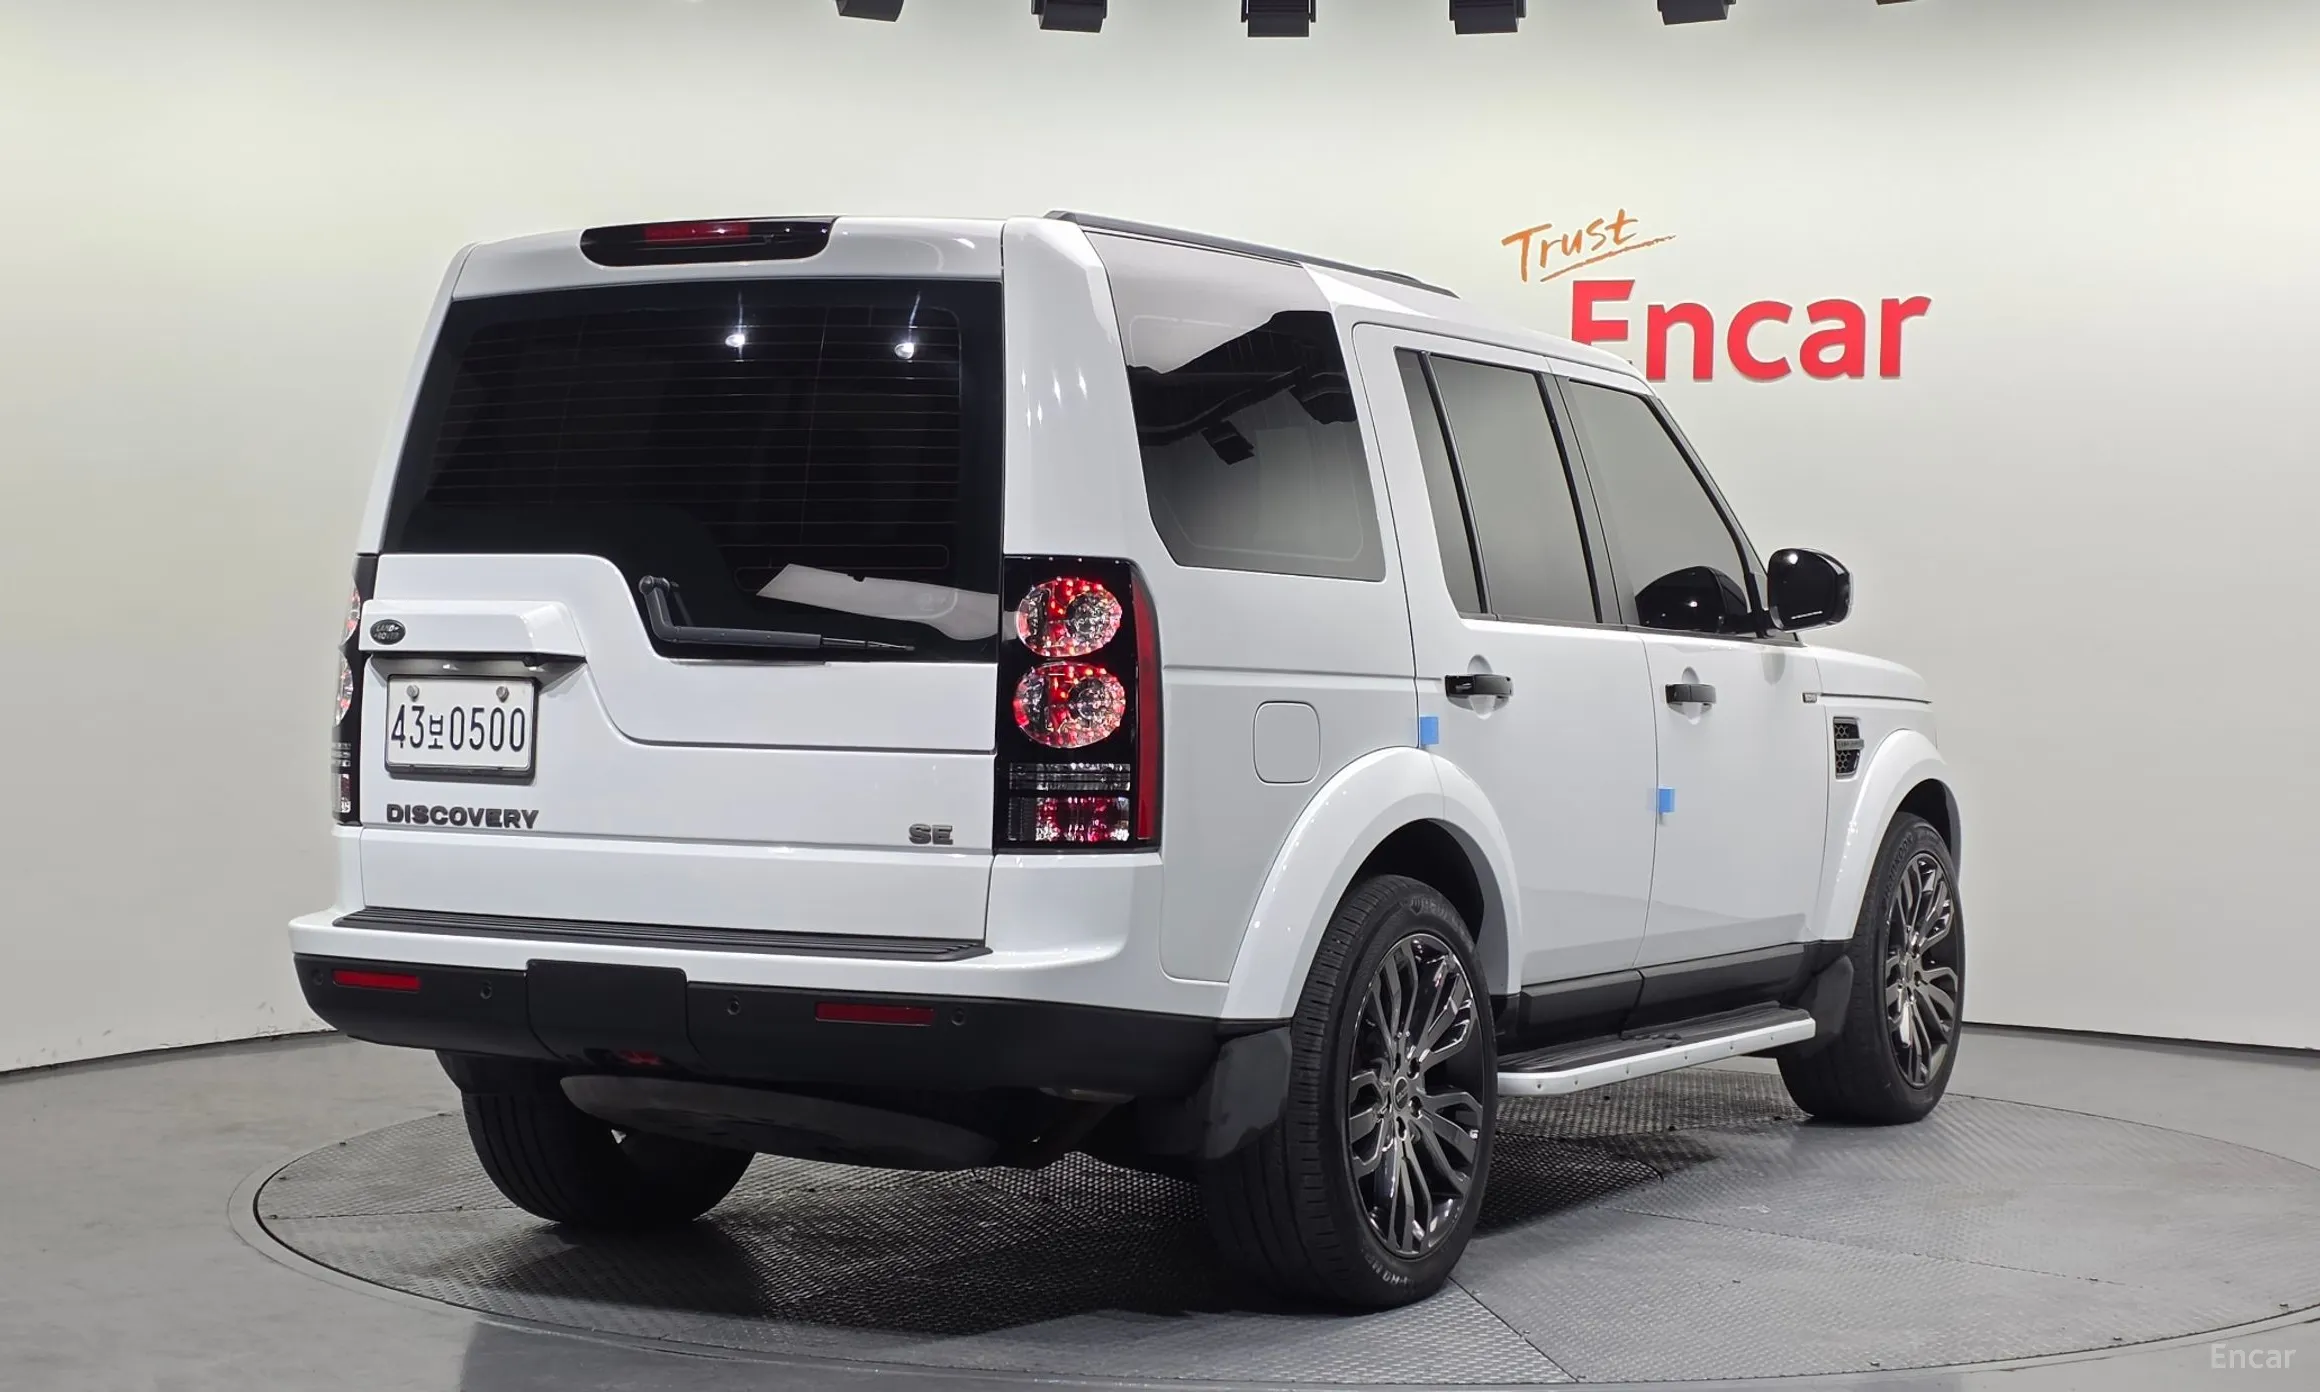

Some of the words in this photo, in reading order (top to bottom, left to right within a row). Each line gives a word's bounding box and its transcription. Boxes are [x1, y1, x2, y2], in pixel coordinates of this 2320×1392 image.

[1501, 208, 1639, 282] Trust
[1571, 279, 1933, 382] Encar
[391, 704, 526, 752] 43보0500
[386, 803, 540, 829] DISCOVERY
[908, 823, 954, 846] SE
